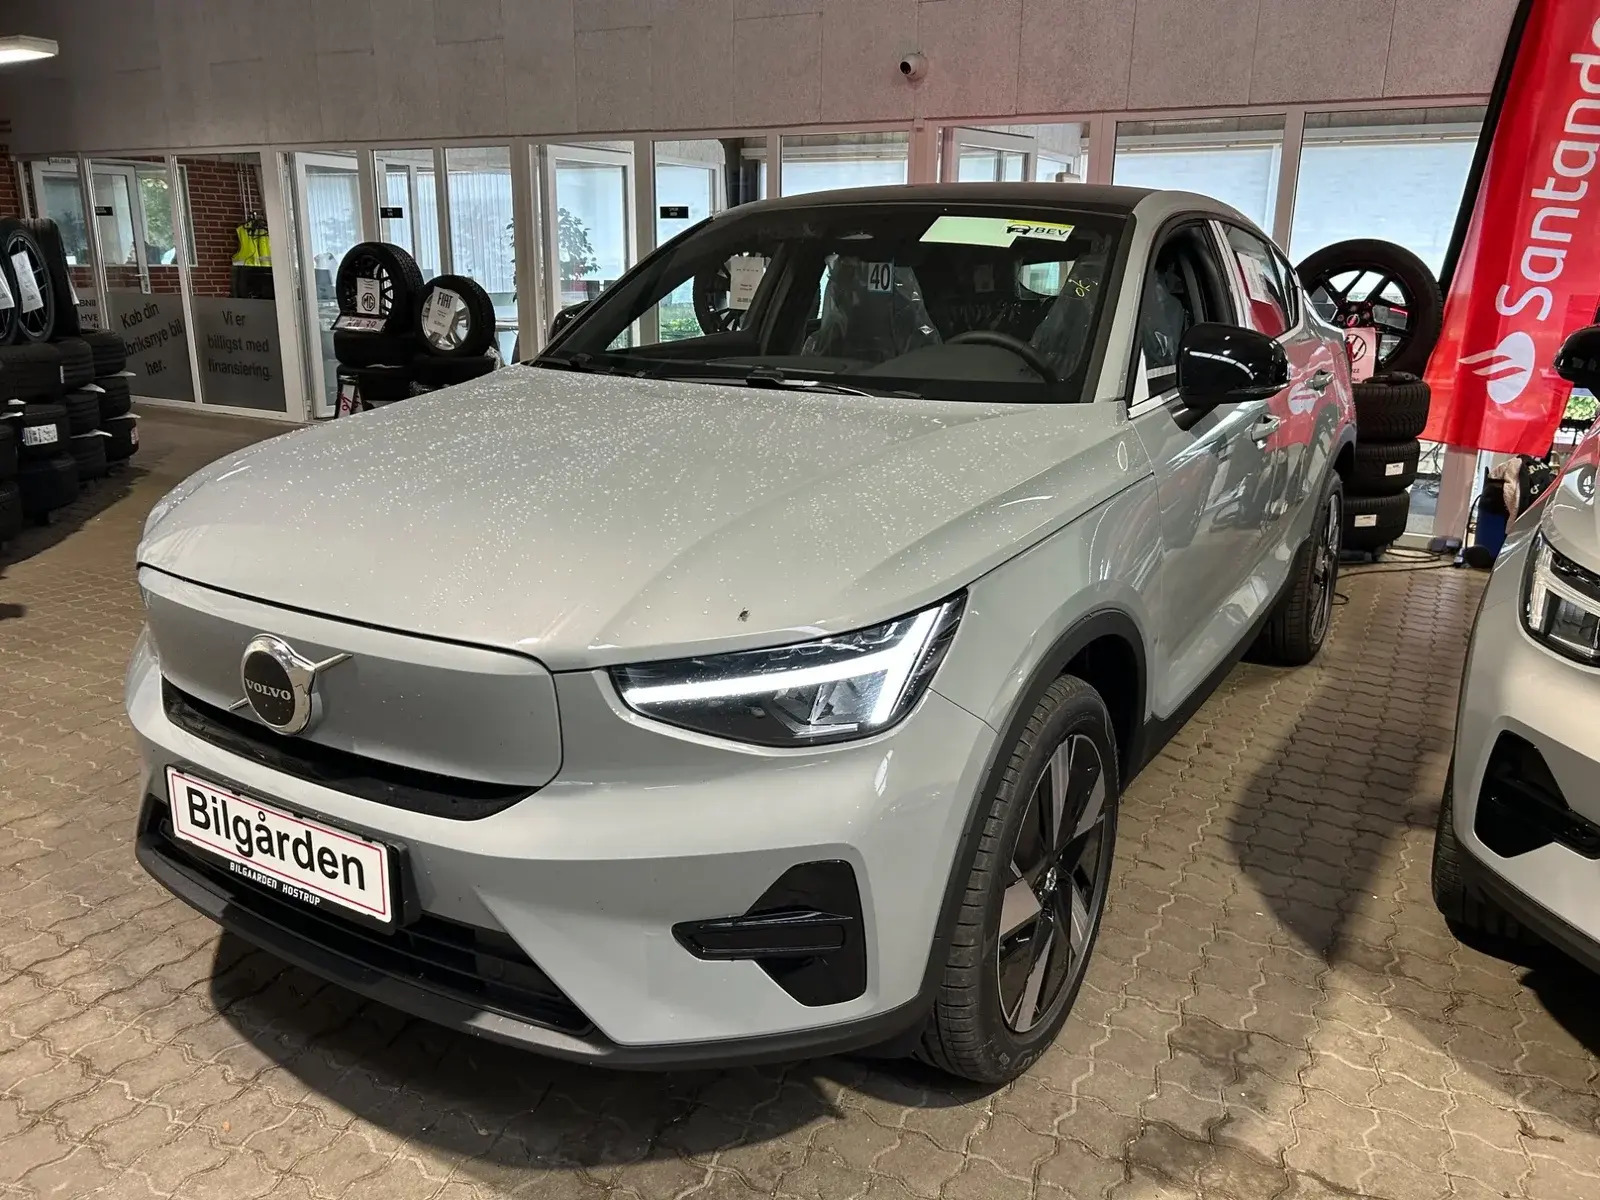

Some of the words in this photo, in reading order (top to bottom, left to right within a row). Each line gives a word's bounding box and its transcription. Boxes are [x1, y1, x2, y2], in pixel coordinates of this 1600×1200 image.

[1495, 17, 1600, 322] Santand
[1034, 226, 1069, 236] BEV
[870, 263, 890, 290] 40
[143, 302, 160, 319] din
[437, 291, 453, 309] FIAT
[222, 310, 233, 325] Vi
[235, 314, 246, 327] er
[124, 328, 169, 357] briksnye
[168, 319, 183, 337] bil
[207, 334, 243, 354] billigst
[246, 338, 269, 352] med
[145, 360, 167, 376] her.
[244, 678, 291, 700] VOLVO
[186, 786, 366, 891] Bilgården
[229, 862, 278, 889] BILGAARDEN
[282, 883, 321, 906] HOSTRUP
